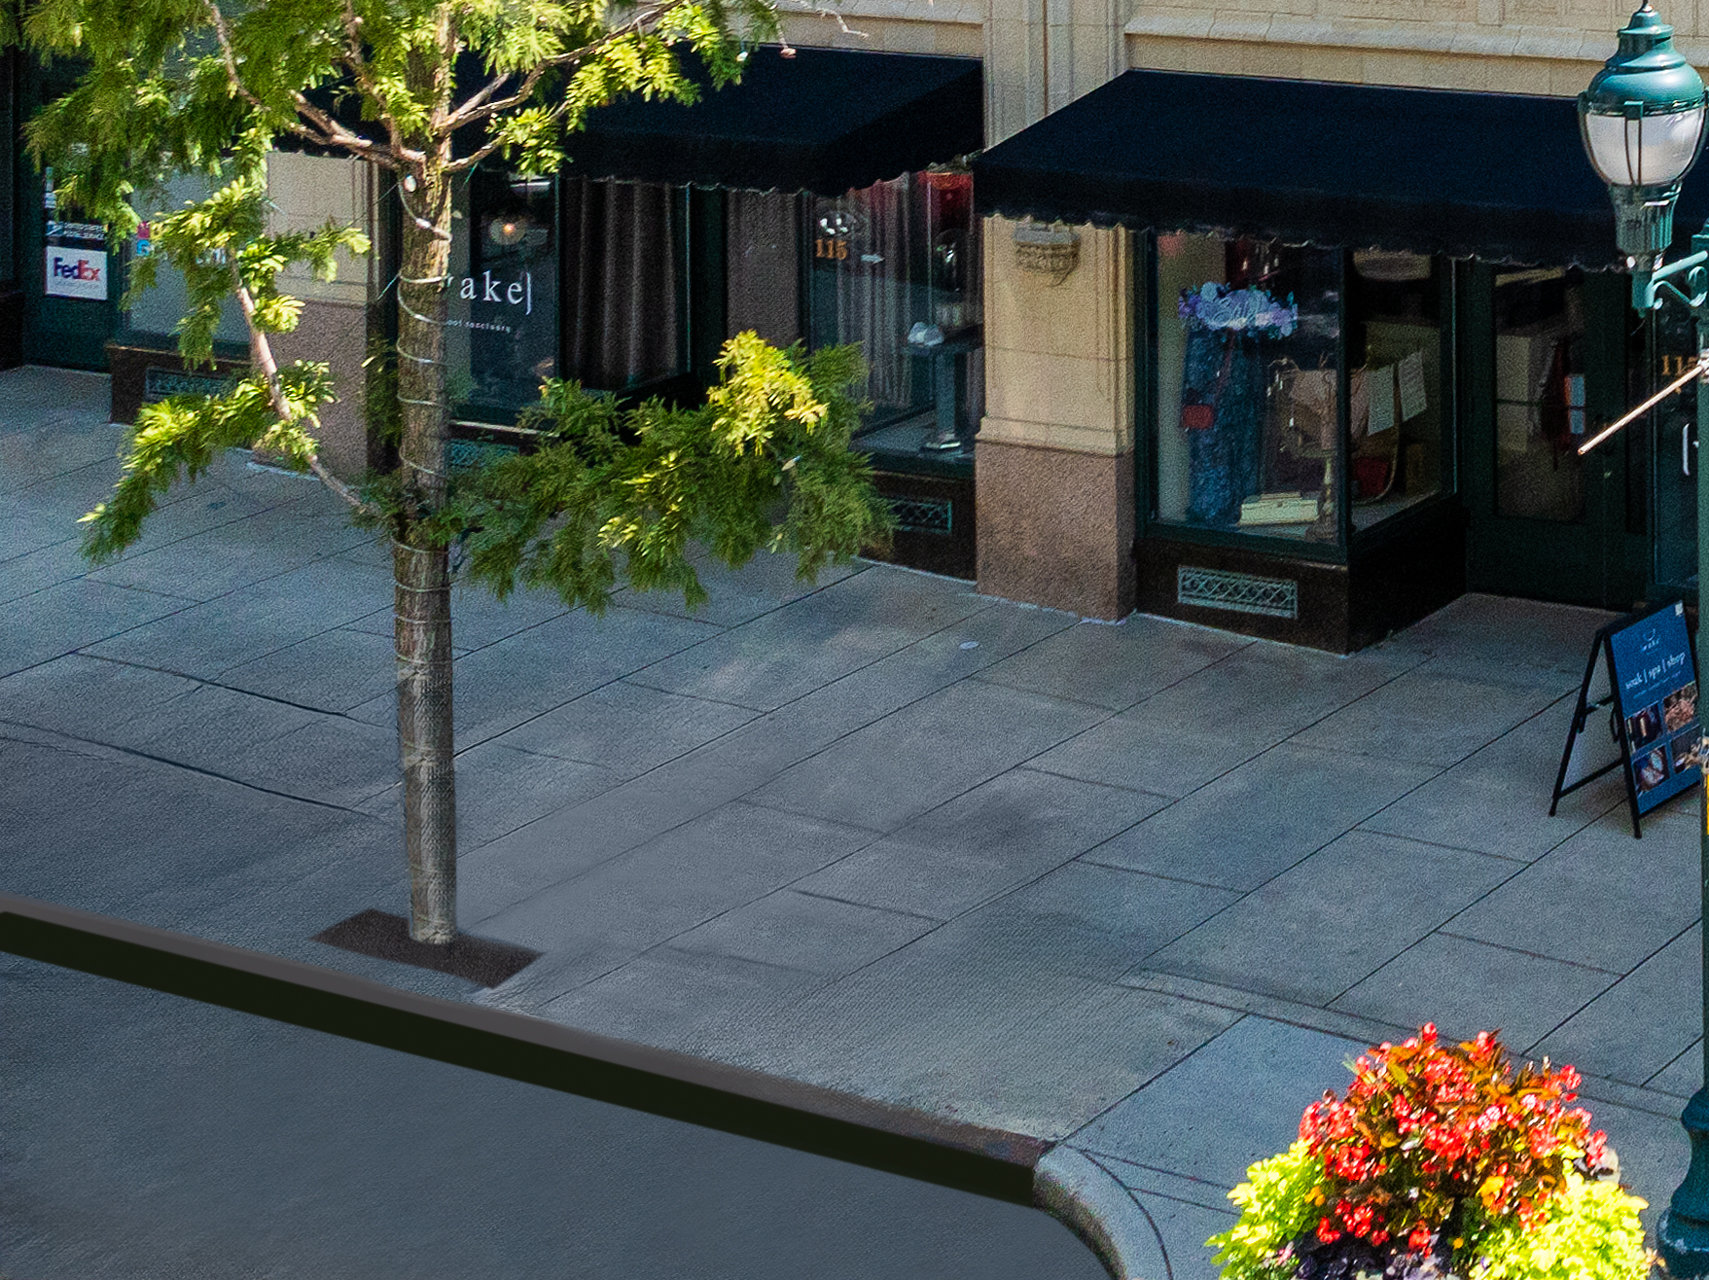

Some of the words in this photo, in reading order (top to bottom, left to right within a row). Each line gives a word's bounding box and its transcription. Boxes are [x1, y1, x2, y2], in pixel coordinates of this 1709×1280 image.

[815, 239, 848, 260] 115
[54, 257, 100, 280] FedEx
[447, 269, 532, 316] ake]
